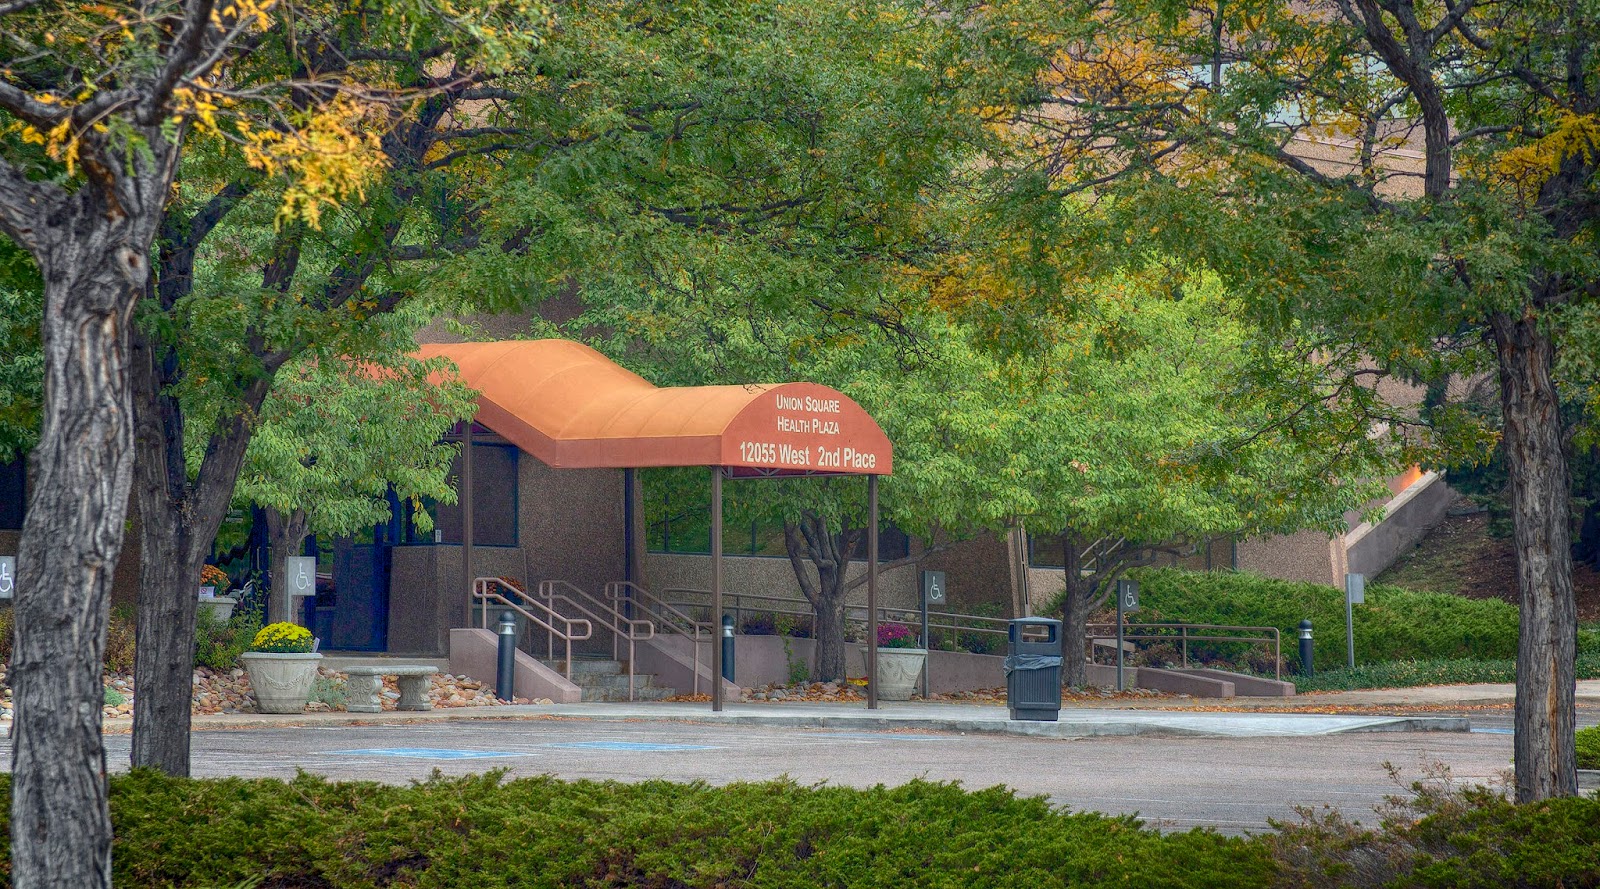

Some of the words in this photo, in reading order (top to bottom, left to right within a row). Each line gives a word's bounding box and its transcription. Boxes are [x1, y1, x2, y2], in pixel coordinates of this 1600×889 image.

[776, 394, 803, 411] UNION
[805, 396, 840, 413] SQUARE
[777, 416, 810, 433] HEALTH
[812, 418, 840, 435] PLAZA
[740, 441, 776, 464] 12055
[779, 444, 810, 466] West
[818, 446, 840, 467] 2nd
[844, 447, 876, 469] Place
